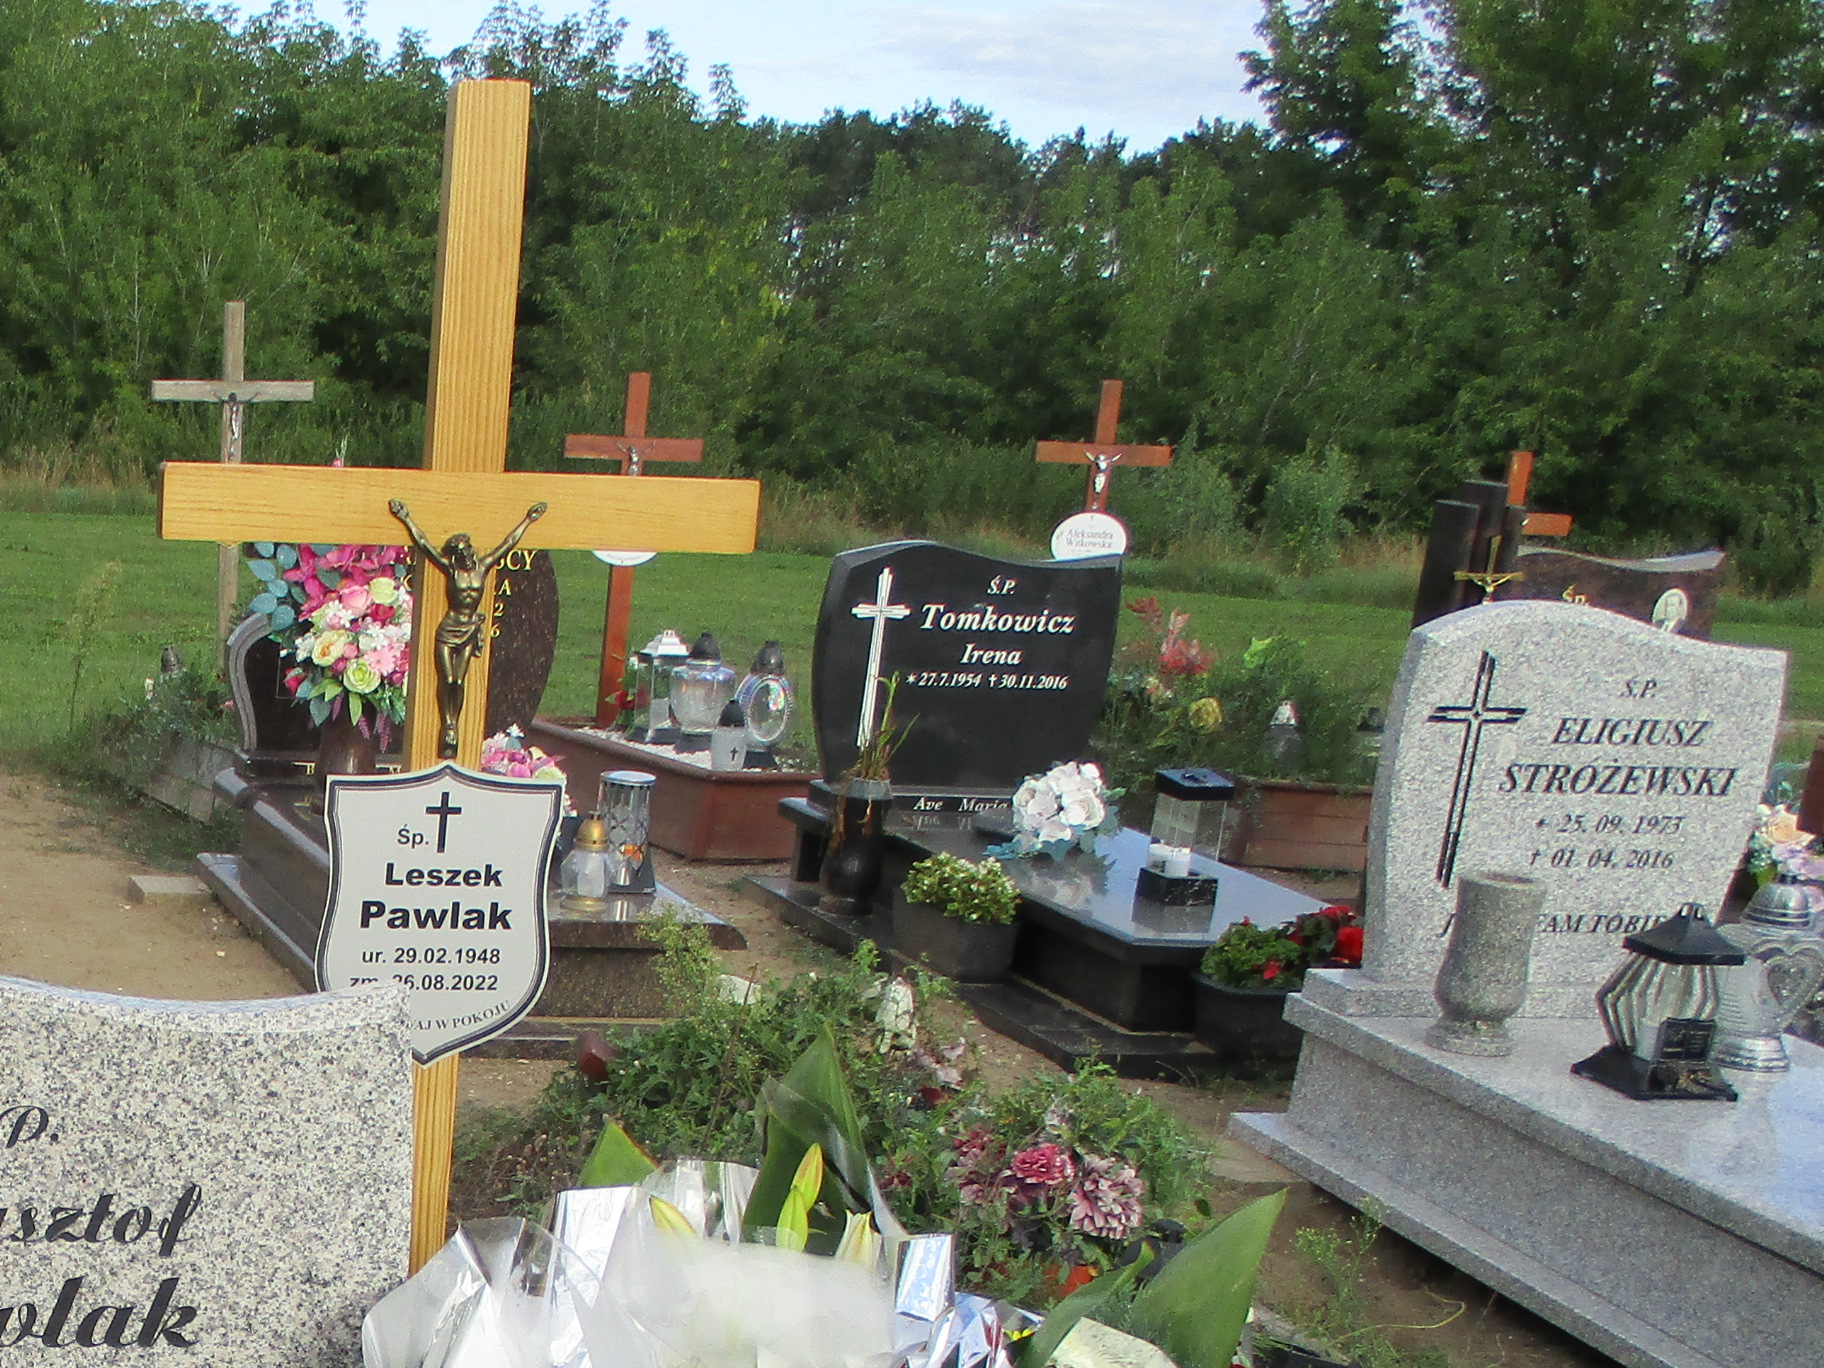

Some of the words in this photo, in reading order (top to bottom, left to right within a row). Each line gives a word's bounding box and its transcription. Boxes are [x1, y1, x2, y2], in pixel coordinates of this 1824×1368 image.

[987, 574, 1017, 595] Ś.P.
[920, 603, 1077, 634] Tomkowicz
[960, 642, 1022, 665] Irena
[917, 672, 982, 687] 27.7.1954
[999, 674, 1069, 690] 30.11.2016
[1552, 717, 1714, 747] ELIGIUSZ
[1499, 758, 1739, 796] STRÓŻEWSKI
[913, 797, 944, 811] Ave
[958, 798, 1010, 812] Maria
[397, 824, 429, 849] Śp.
[385, 862, 503, 887] Leszek
[360, 900, 513, 930] Pawlak
[362, 949, 387, 964] ur.
[393, 948, 501, 965] 29.02.1948
[435, 1019, 450, 1030] W
[452, 1001, 511, 1029] POKOJU
